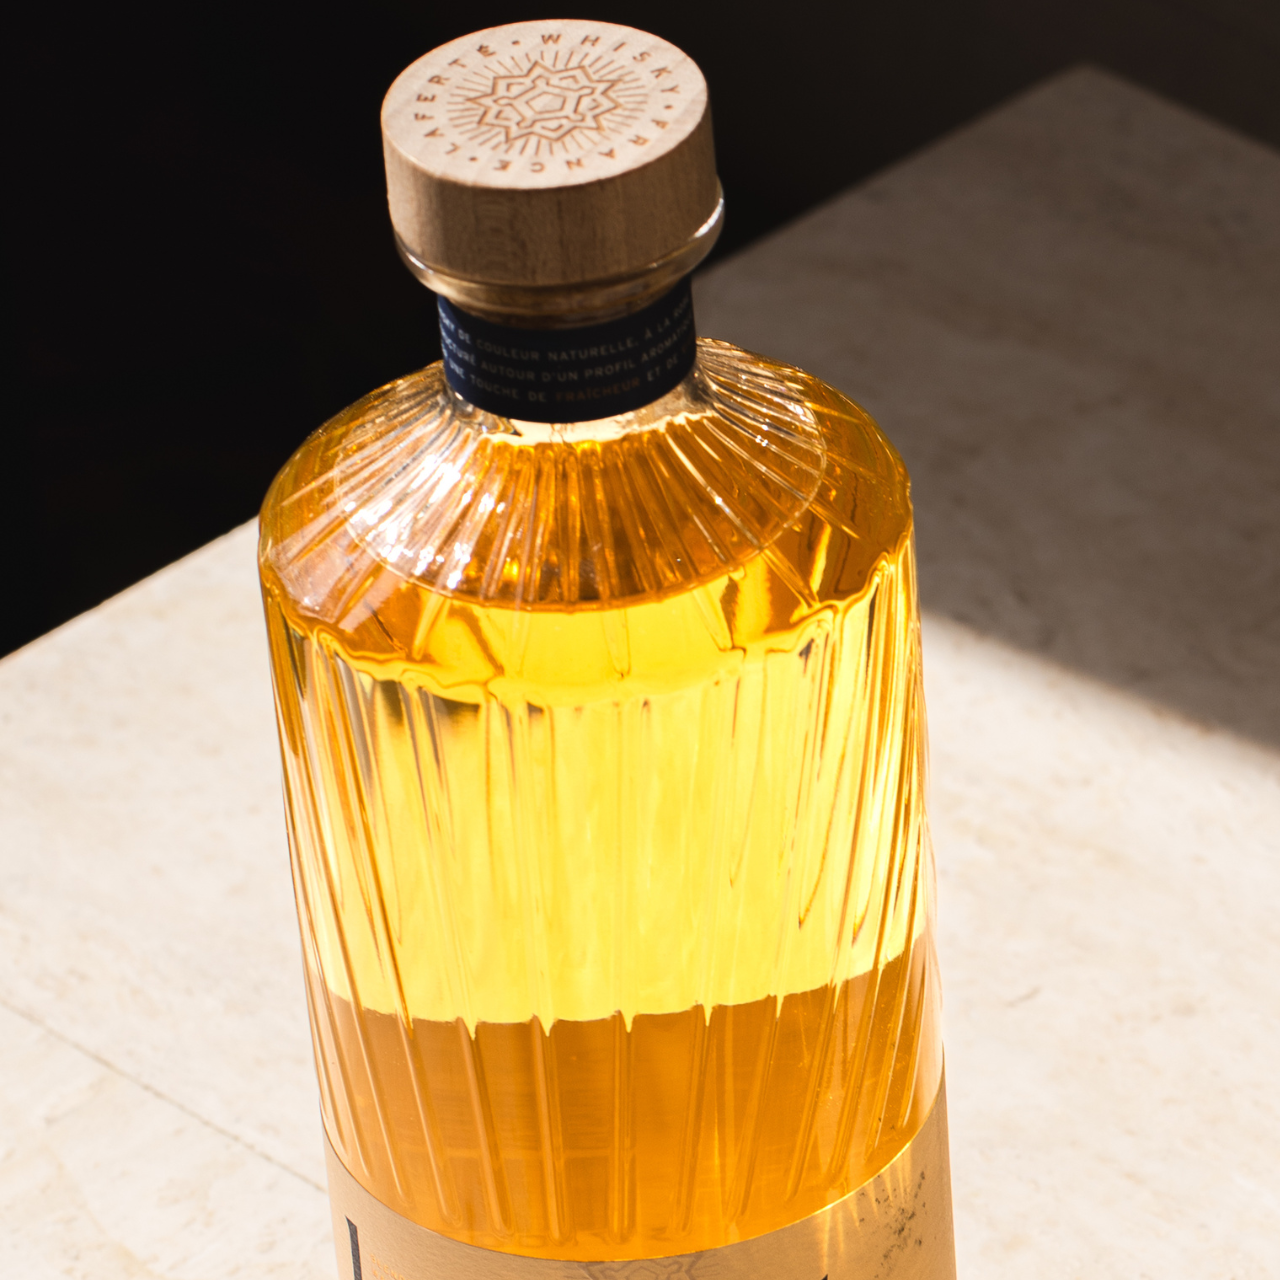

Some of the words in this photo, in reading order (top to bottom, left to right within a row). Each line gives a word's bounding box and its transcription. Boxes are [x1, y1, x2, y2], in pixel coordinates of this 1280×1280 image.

[541, 34, 681, 96] WHISKY
[492, 118, 670, 173] FRANCE
[475, 338, 541, 361] COULEUR
[470, 374, 519, 399] TOUCHE
[527, 390, 547, 402] DE
[646, 366, 662, 383] ET
[480, 360, 536, 382] AUTOUR
[541, 370, 578, 382] D'UN
[584, 358, 636, 379] PROFIL
